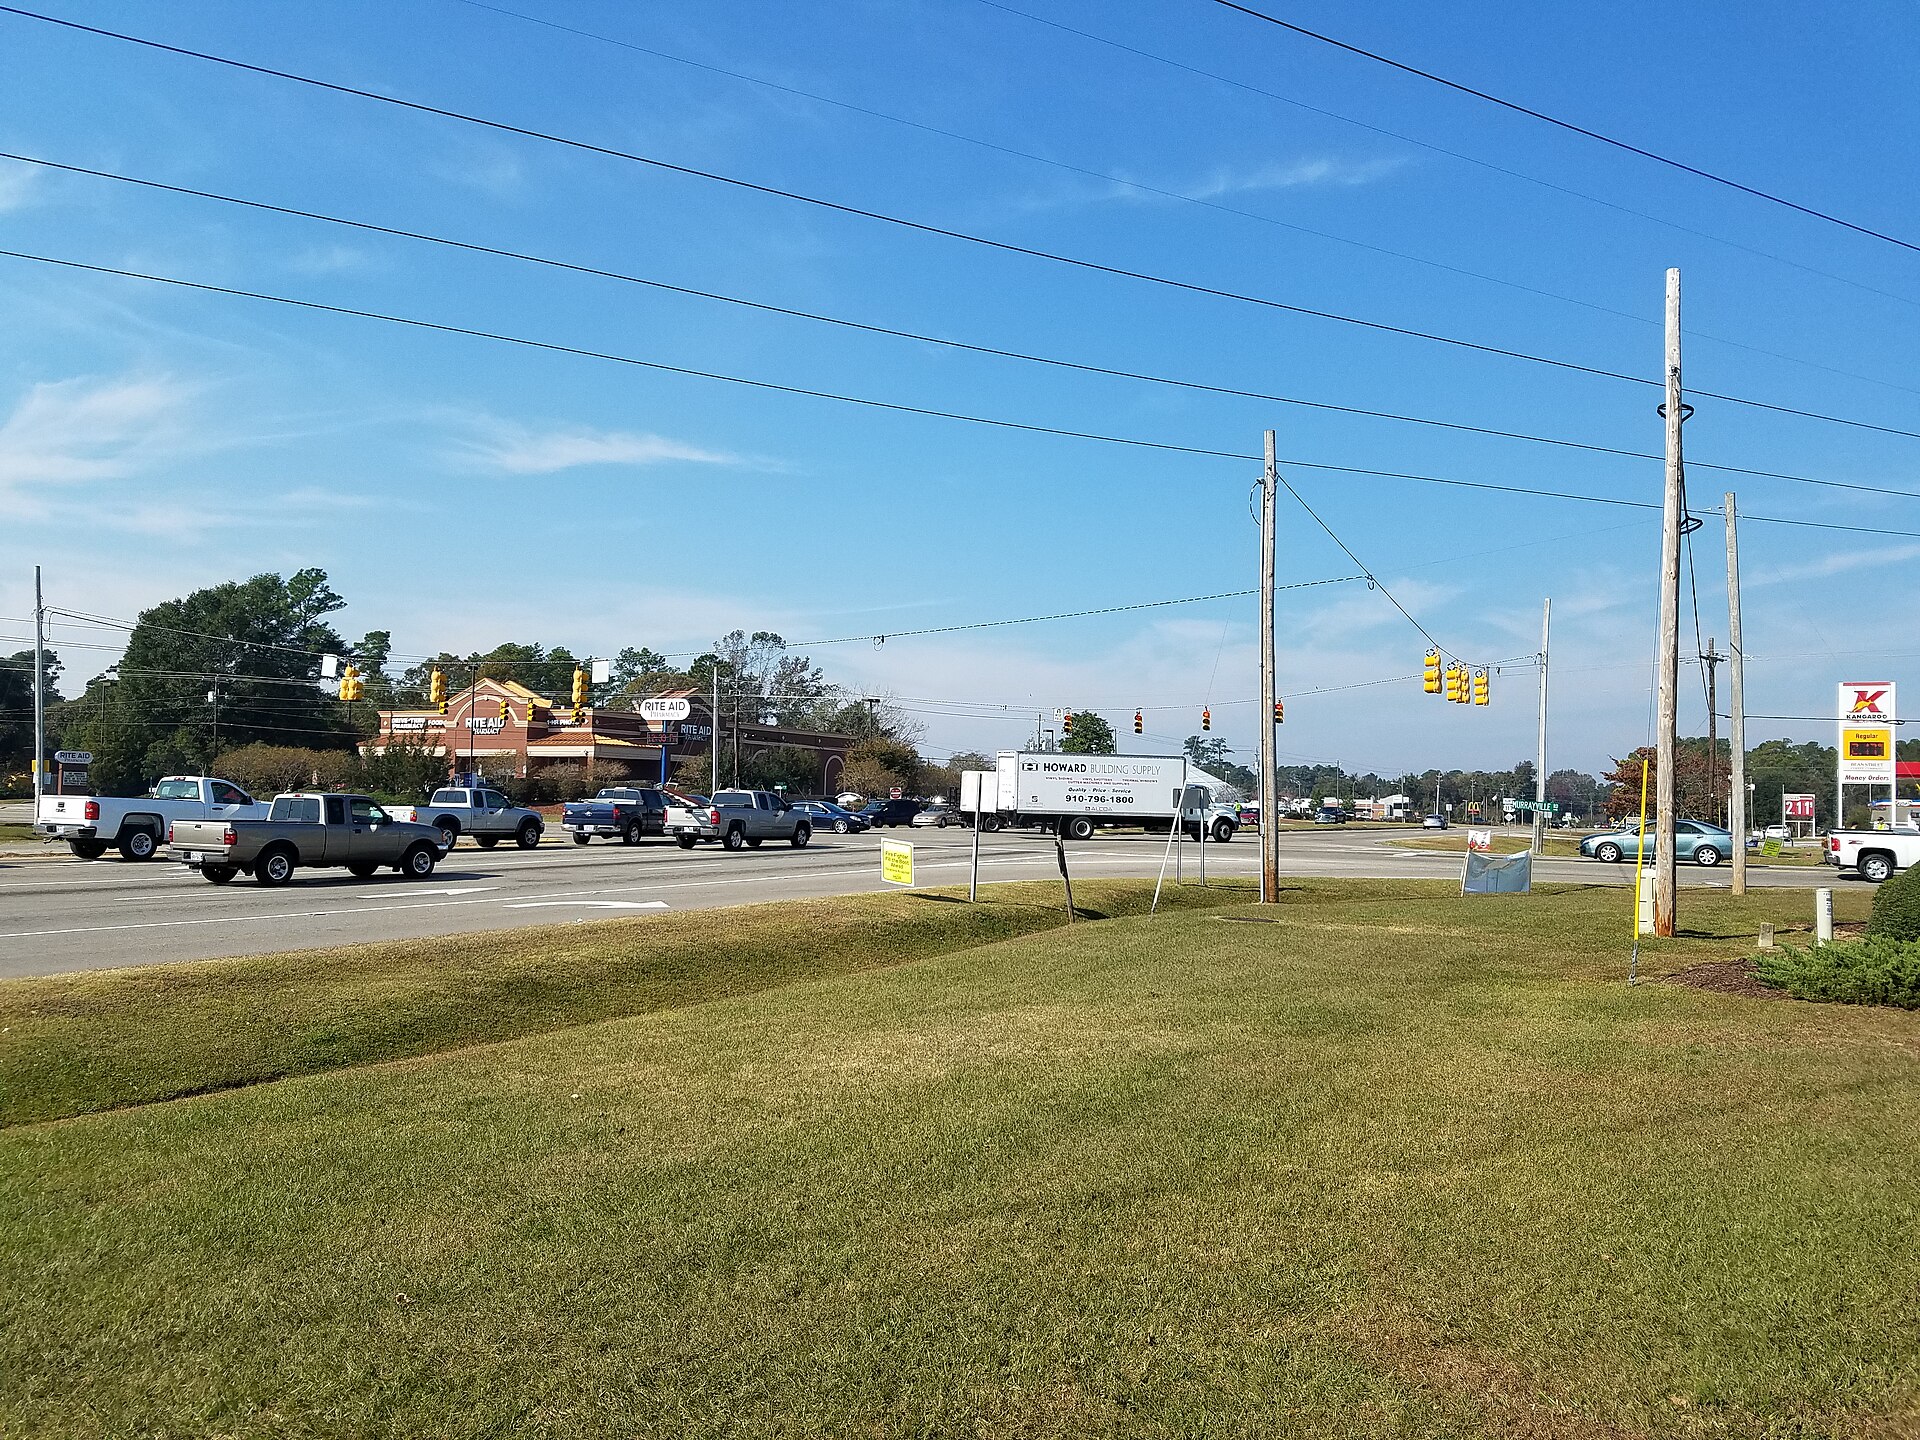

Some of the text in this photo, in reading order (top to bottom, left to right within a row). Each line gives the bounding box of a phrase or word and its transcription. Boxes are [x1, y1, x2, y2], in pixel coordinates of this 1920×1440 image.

[645, 701, 686, 711] RITE AID
[464, 717, 505, 728] RITE AID
[680, 723, 712, 736] RITE AID
[1043, 762, 1161, 776] HOWARD BUILDING SUPPLY
[1845, 774, 1867, 782] Money
[1065, 794, 1134, 804] 910-796-1800
[1512, 800, 1551, 811] MURRAYVILLE
